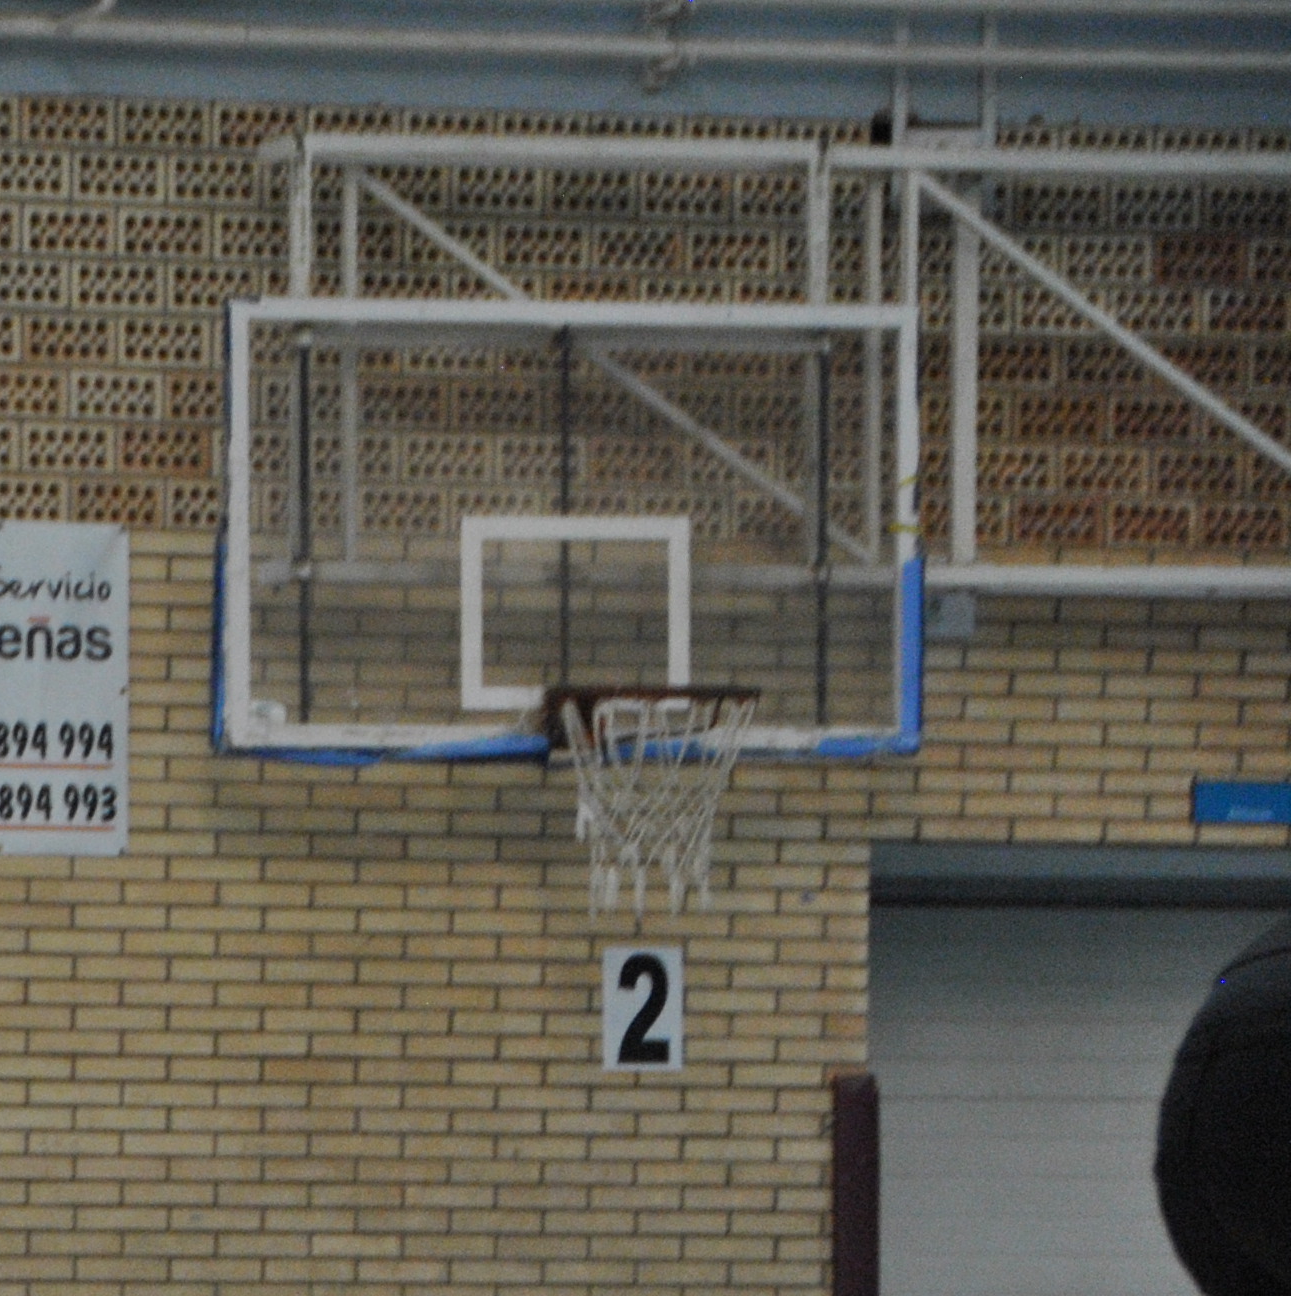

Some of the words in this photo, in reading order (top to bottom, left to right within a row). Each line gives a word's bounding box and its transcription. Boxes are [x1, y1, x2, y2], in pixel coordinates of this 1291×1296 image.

[59, 721, 115, 761] 994
[64, 783, 118, 823] 993
[617, 953, 671, 1065] 2
